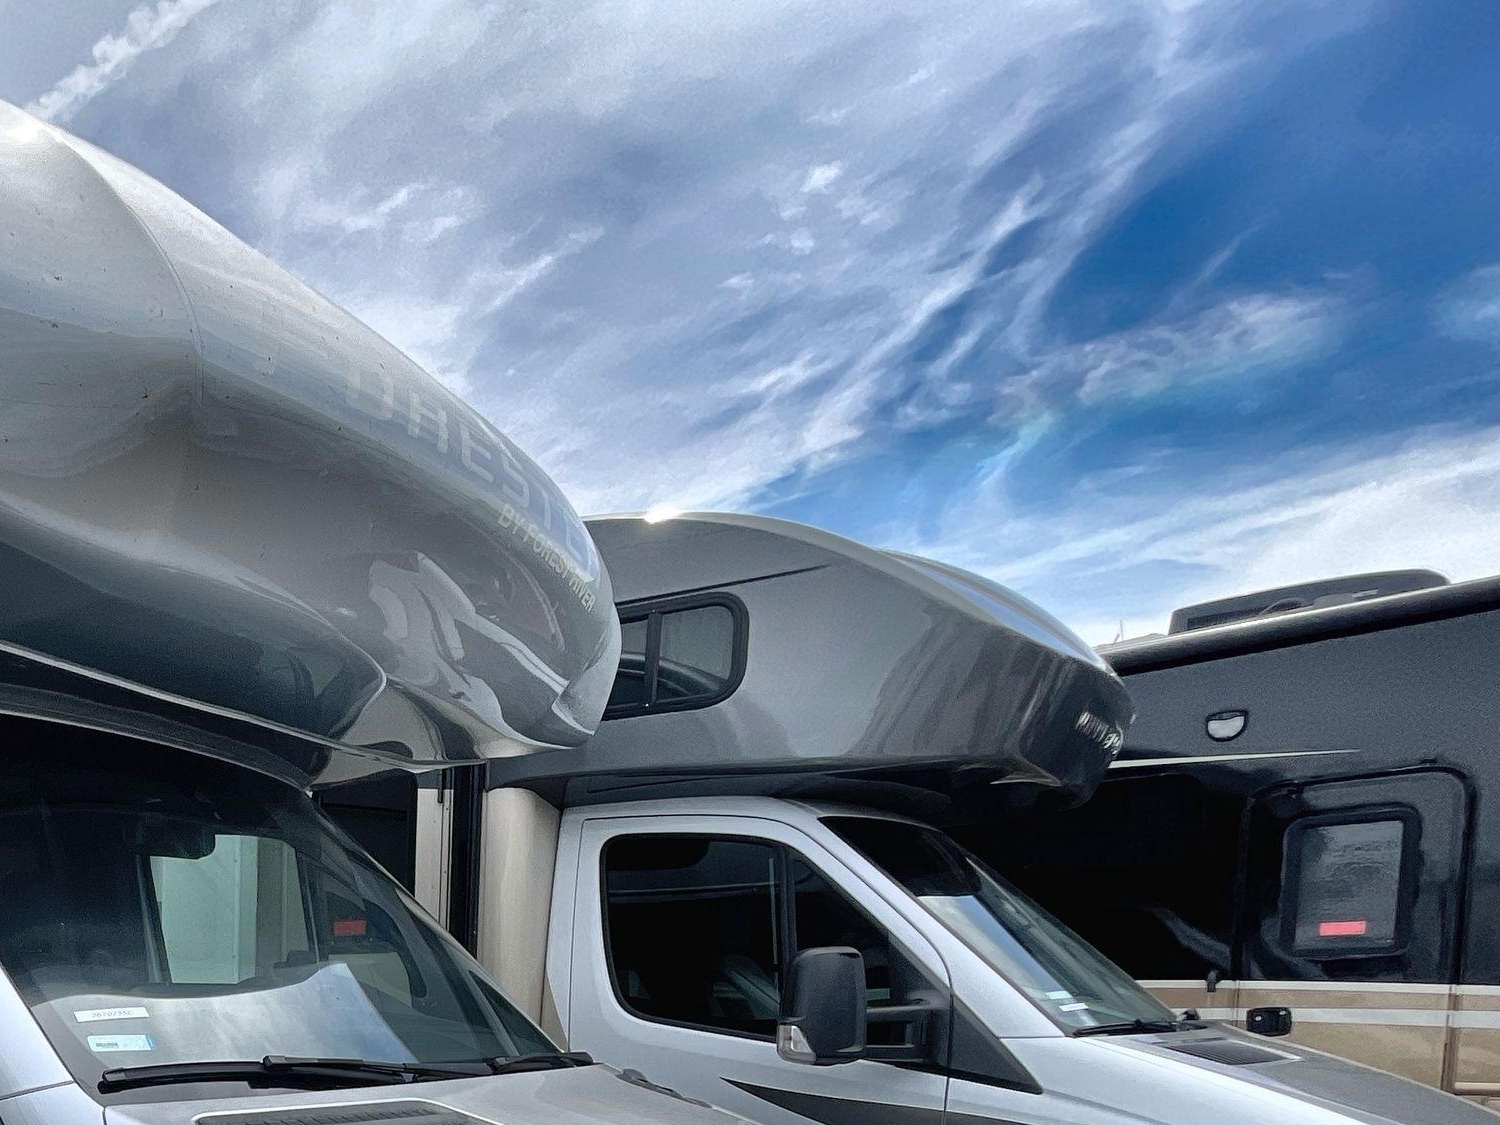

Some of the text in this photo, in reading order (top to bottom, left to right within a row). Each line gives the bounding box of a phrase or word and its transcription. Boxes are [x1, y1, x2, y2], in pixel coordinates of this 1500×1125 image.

[498, 503, 597, 613] BY FOREST RIVER
